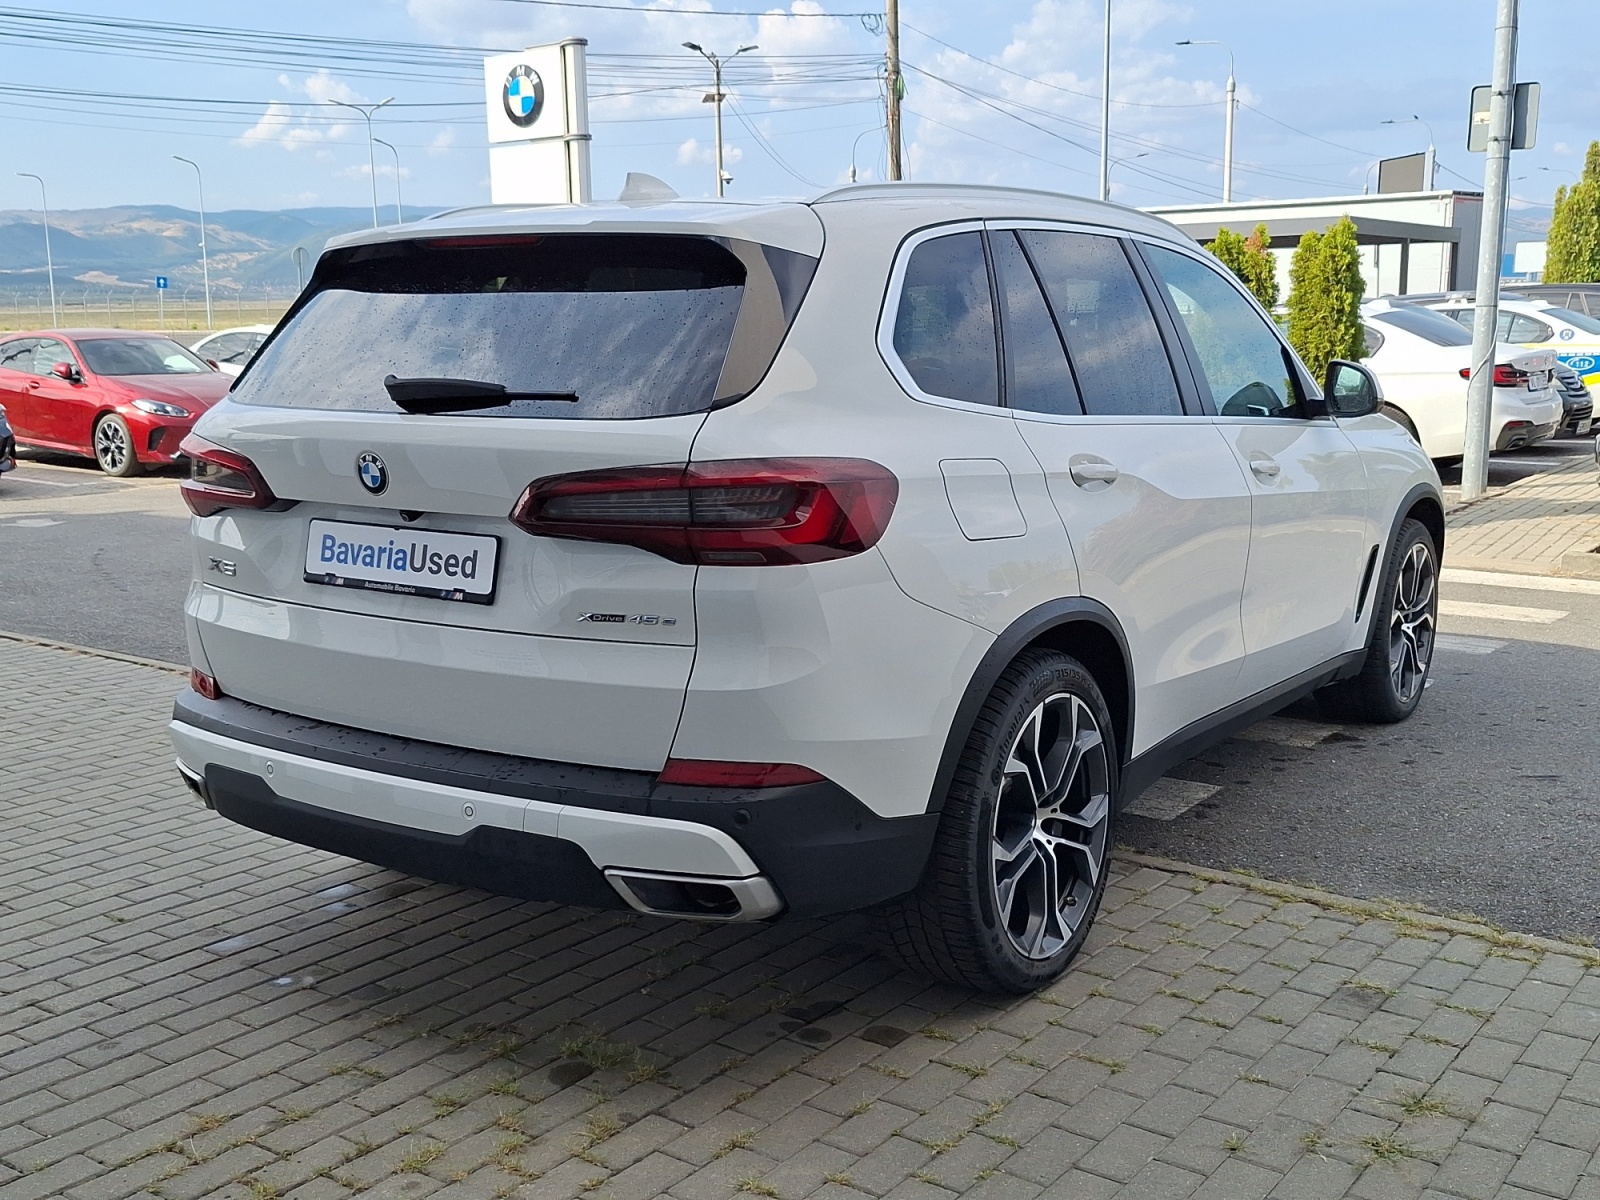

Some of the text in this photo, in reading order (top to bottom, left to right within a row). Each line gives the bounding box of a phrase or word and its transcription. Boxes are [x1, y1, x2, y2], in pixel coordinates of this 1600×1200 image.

[505, 65, 540, 88] BMW
[1575, 359, 1589, 368] 112
[359, 454, 383, 469] BMW
[320, 533, 479, 580] BavariaUsed
[208, 555, 237, 577] X5
[364, 581, 416, 593] Automobile Bavaria
[627, 613, 660, 626] 45
[991, 704, 1025, 788] Continental
